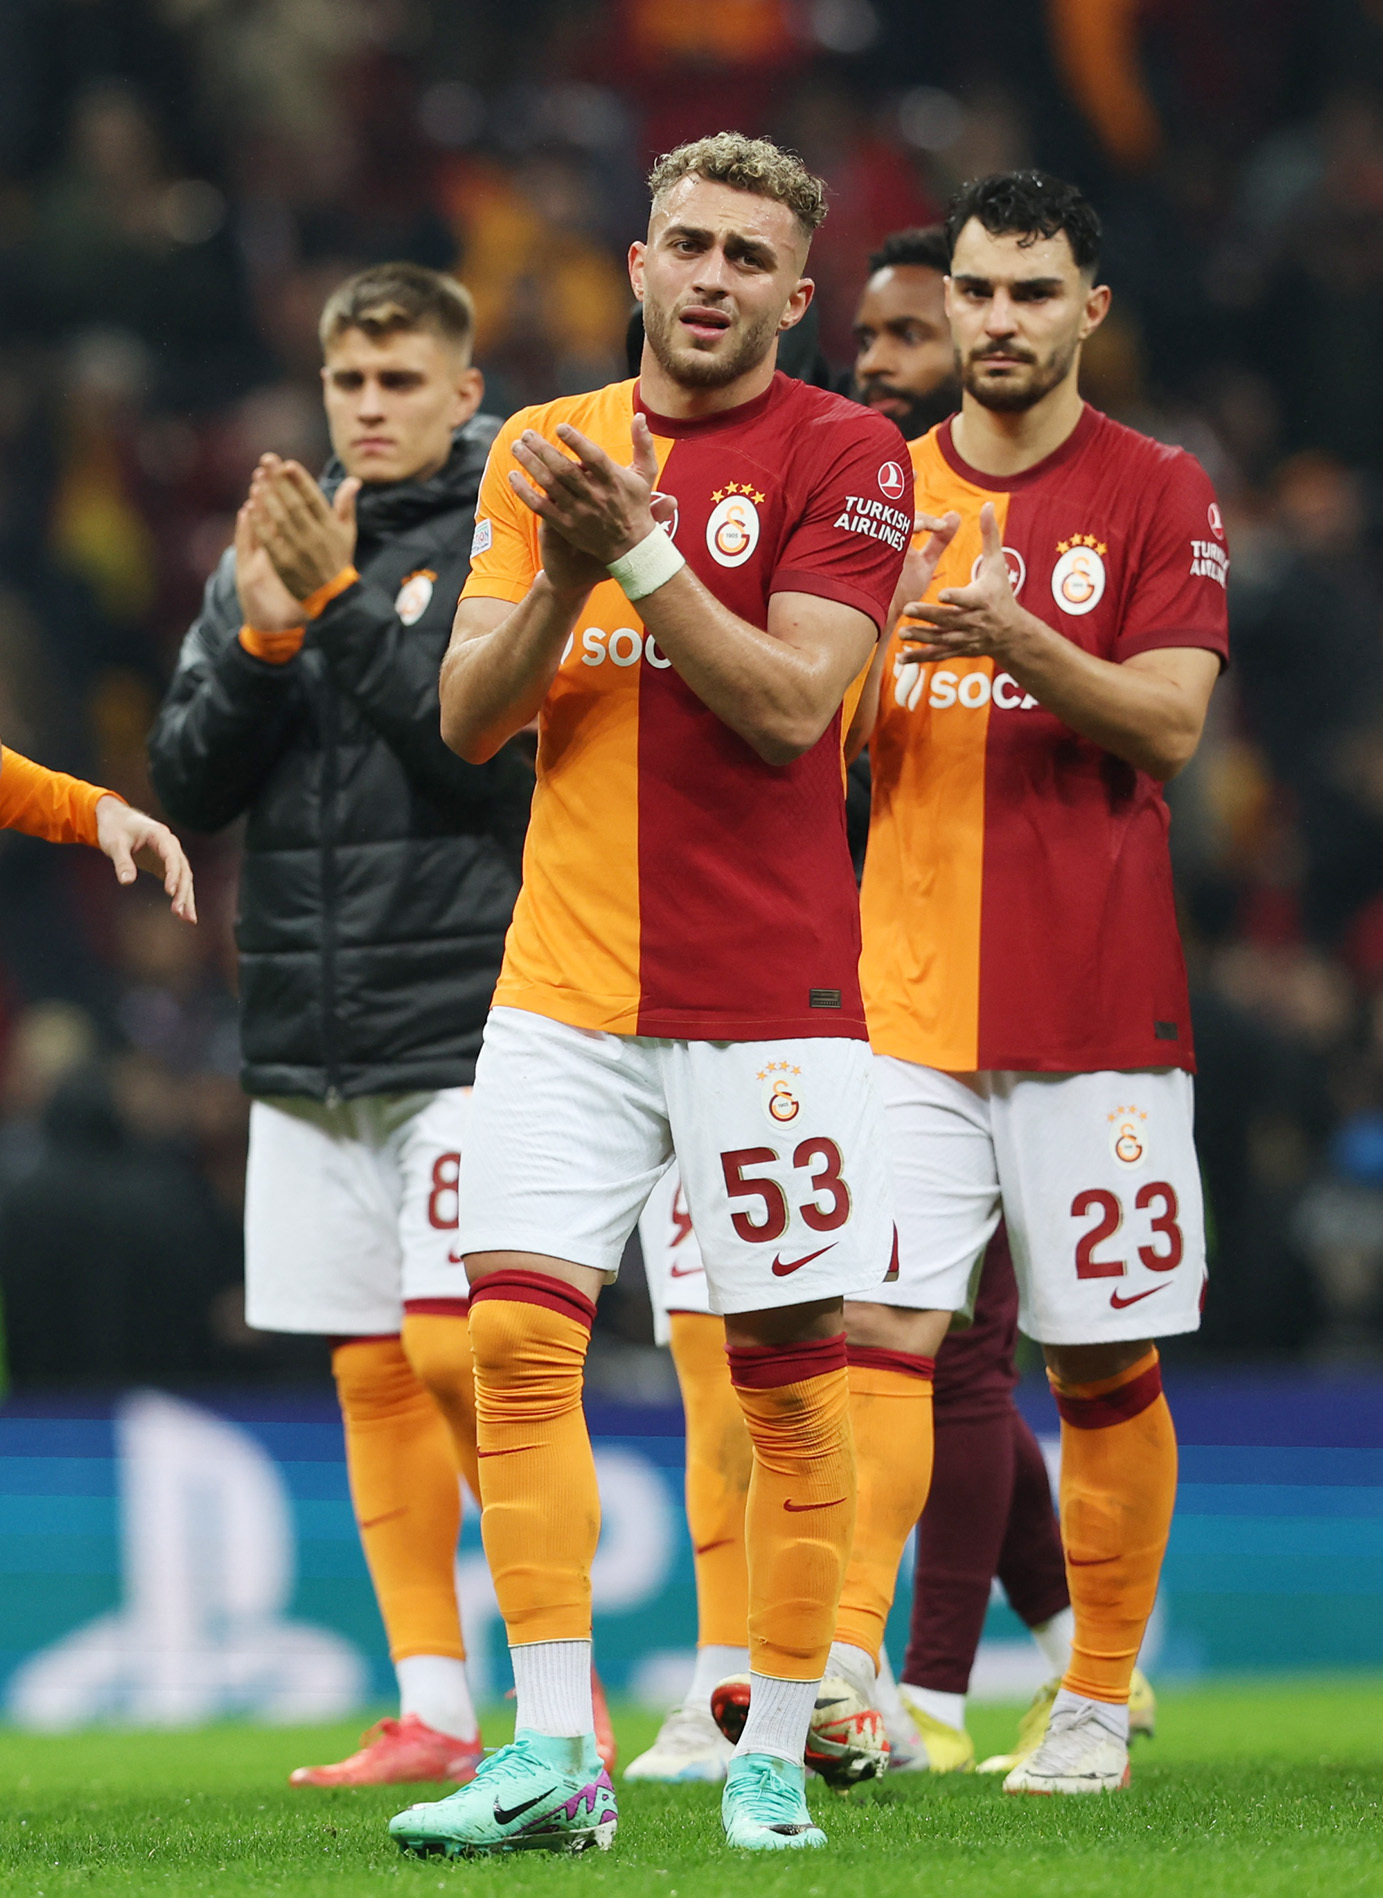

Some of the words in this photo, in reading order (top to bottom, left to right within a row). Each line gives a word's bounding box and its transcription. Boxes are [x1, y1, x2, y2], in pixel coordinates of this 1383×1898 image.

[833, 513, 906, 552] AIRLINES
[845, 496, 911, 535] TURKISH
[719, 1136, 853, 1244] 53
[1070, 1180, 1185, 1280] 23
